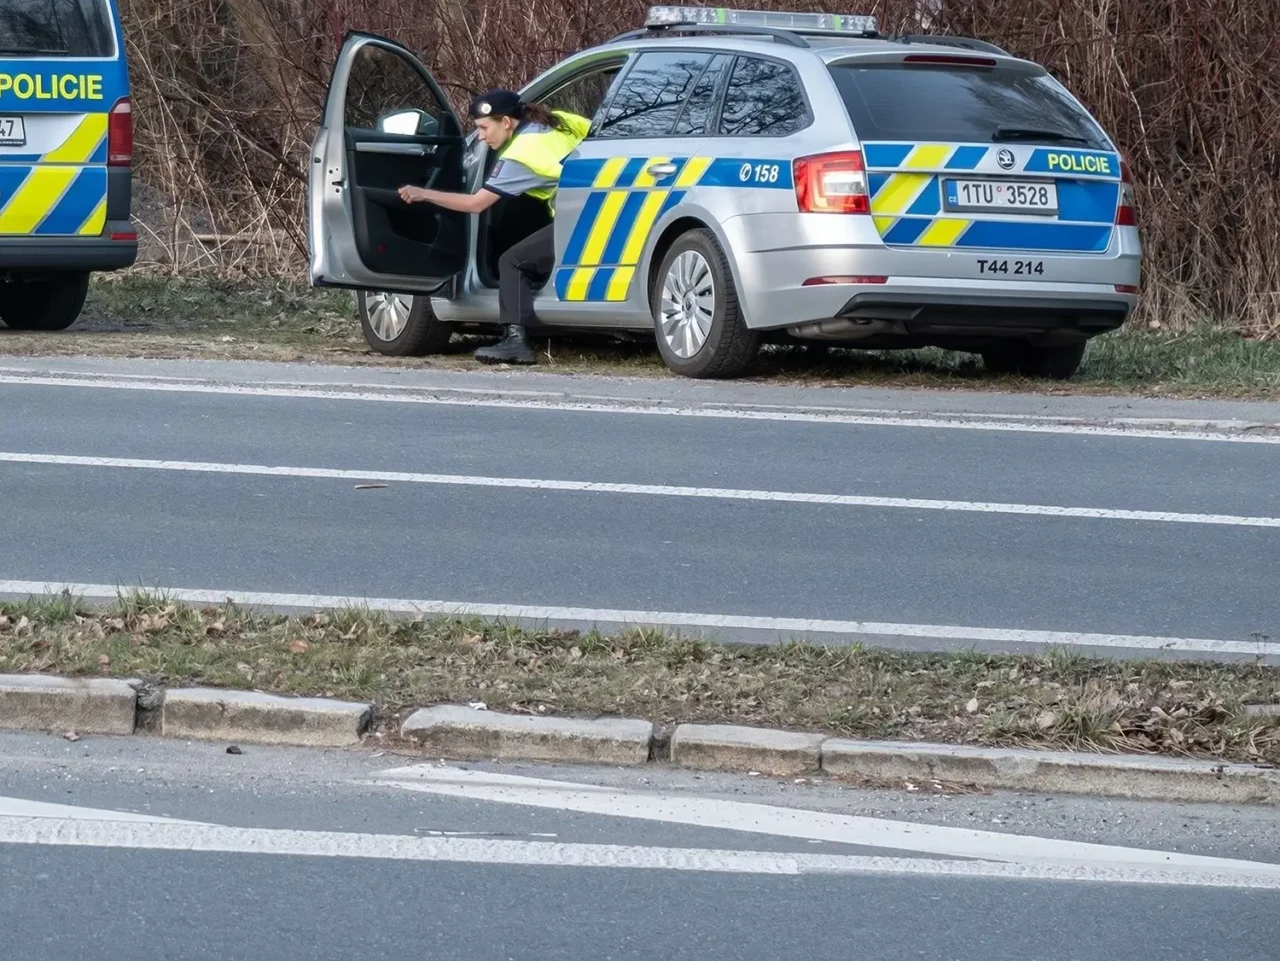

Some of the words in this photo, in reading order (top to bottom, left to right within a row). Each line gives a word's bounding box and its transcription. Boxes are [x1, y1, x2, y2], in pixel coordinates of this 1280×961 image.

[1047, 153, 1110, 173] POLICIE
[754, 164, 779, 183] 158
[962, 183, 994, 204] 1TU
[1006, 186, 1049, 206] 3528
[977, 259, 1009, 274] T44
[1014, 260, 1044, 275] 214
